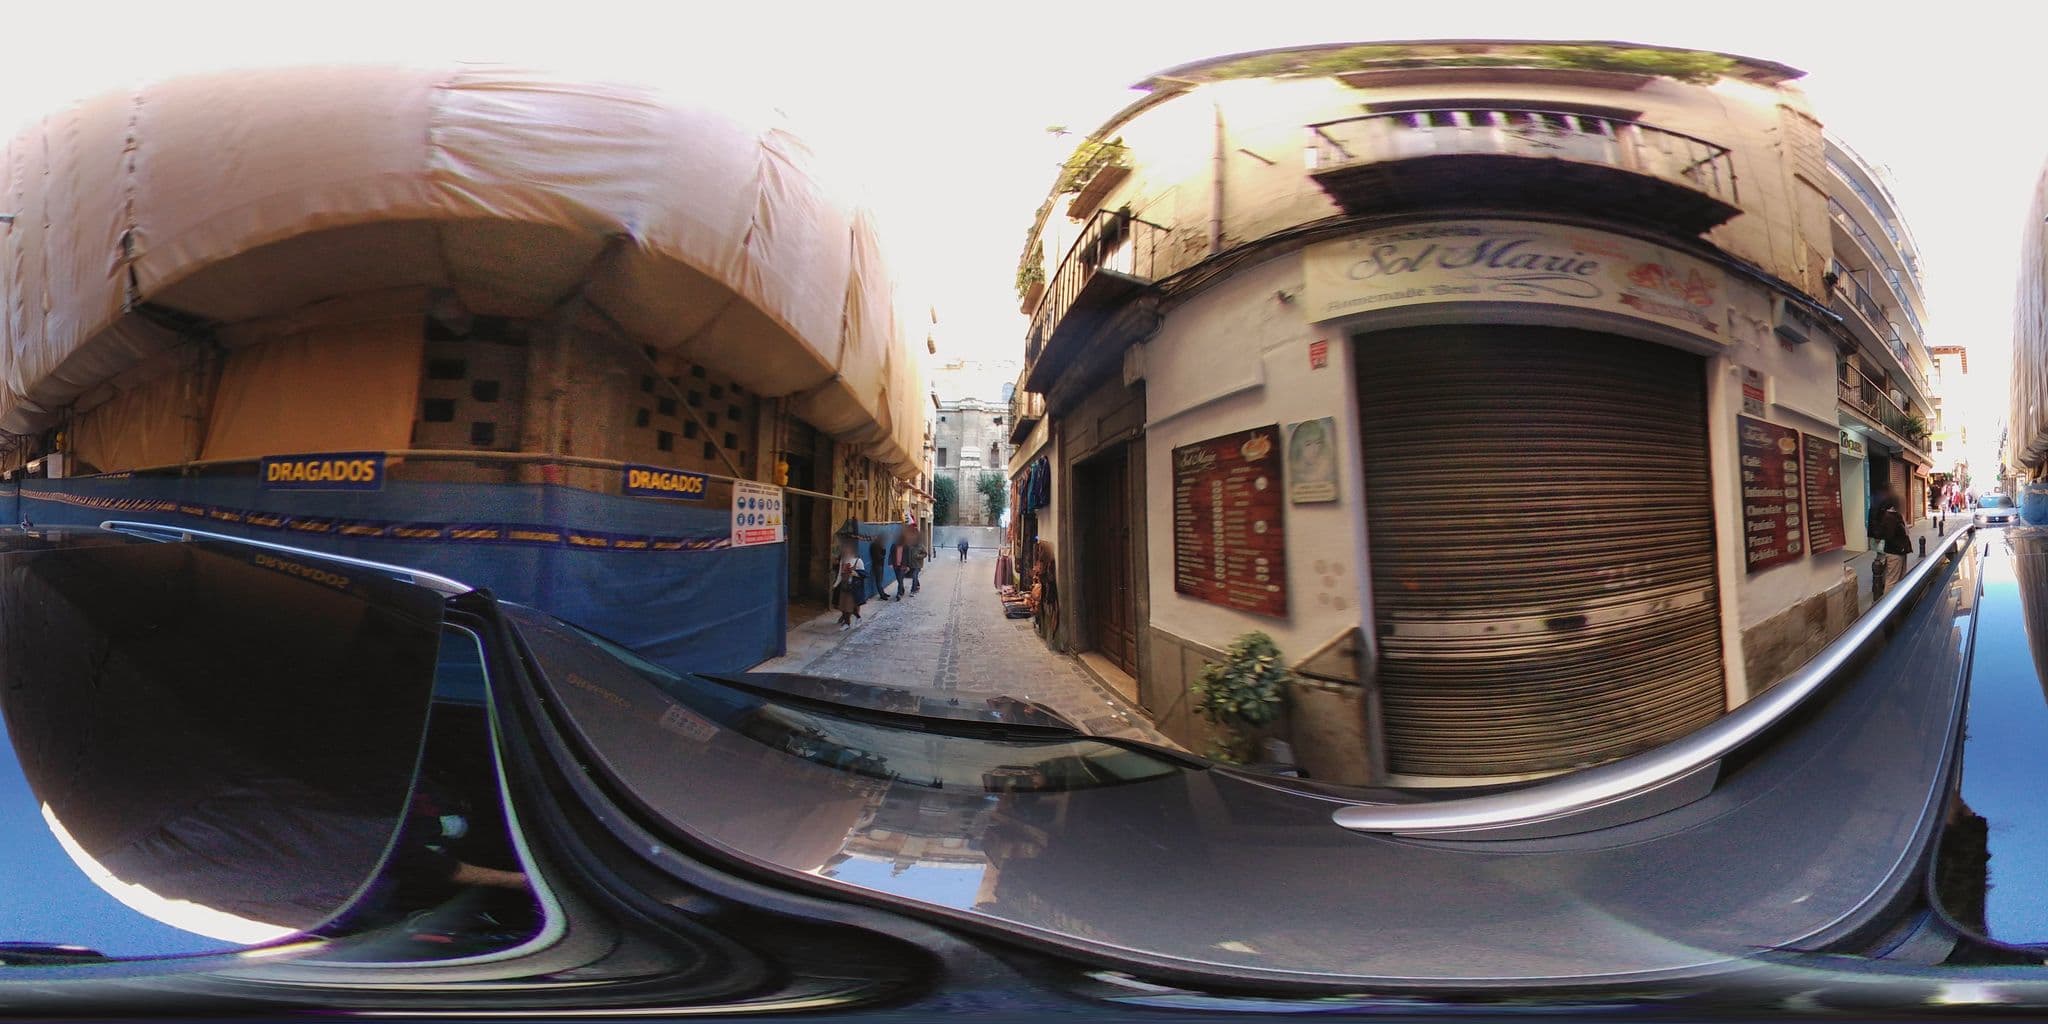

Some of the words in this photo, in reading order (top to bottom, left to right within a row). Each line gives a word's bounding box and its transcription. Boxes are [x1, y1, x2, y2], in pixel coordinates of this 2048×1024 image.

[1348, 244, 1438, 280] Sol
[1438, 238, 1600, 276] Marie
[267, 459, 376, 482] DRAGADOS
[628, 469, 703, 493] DRAGADOS
